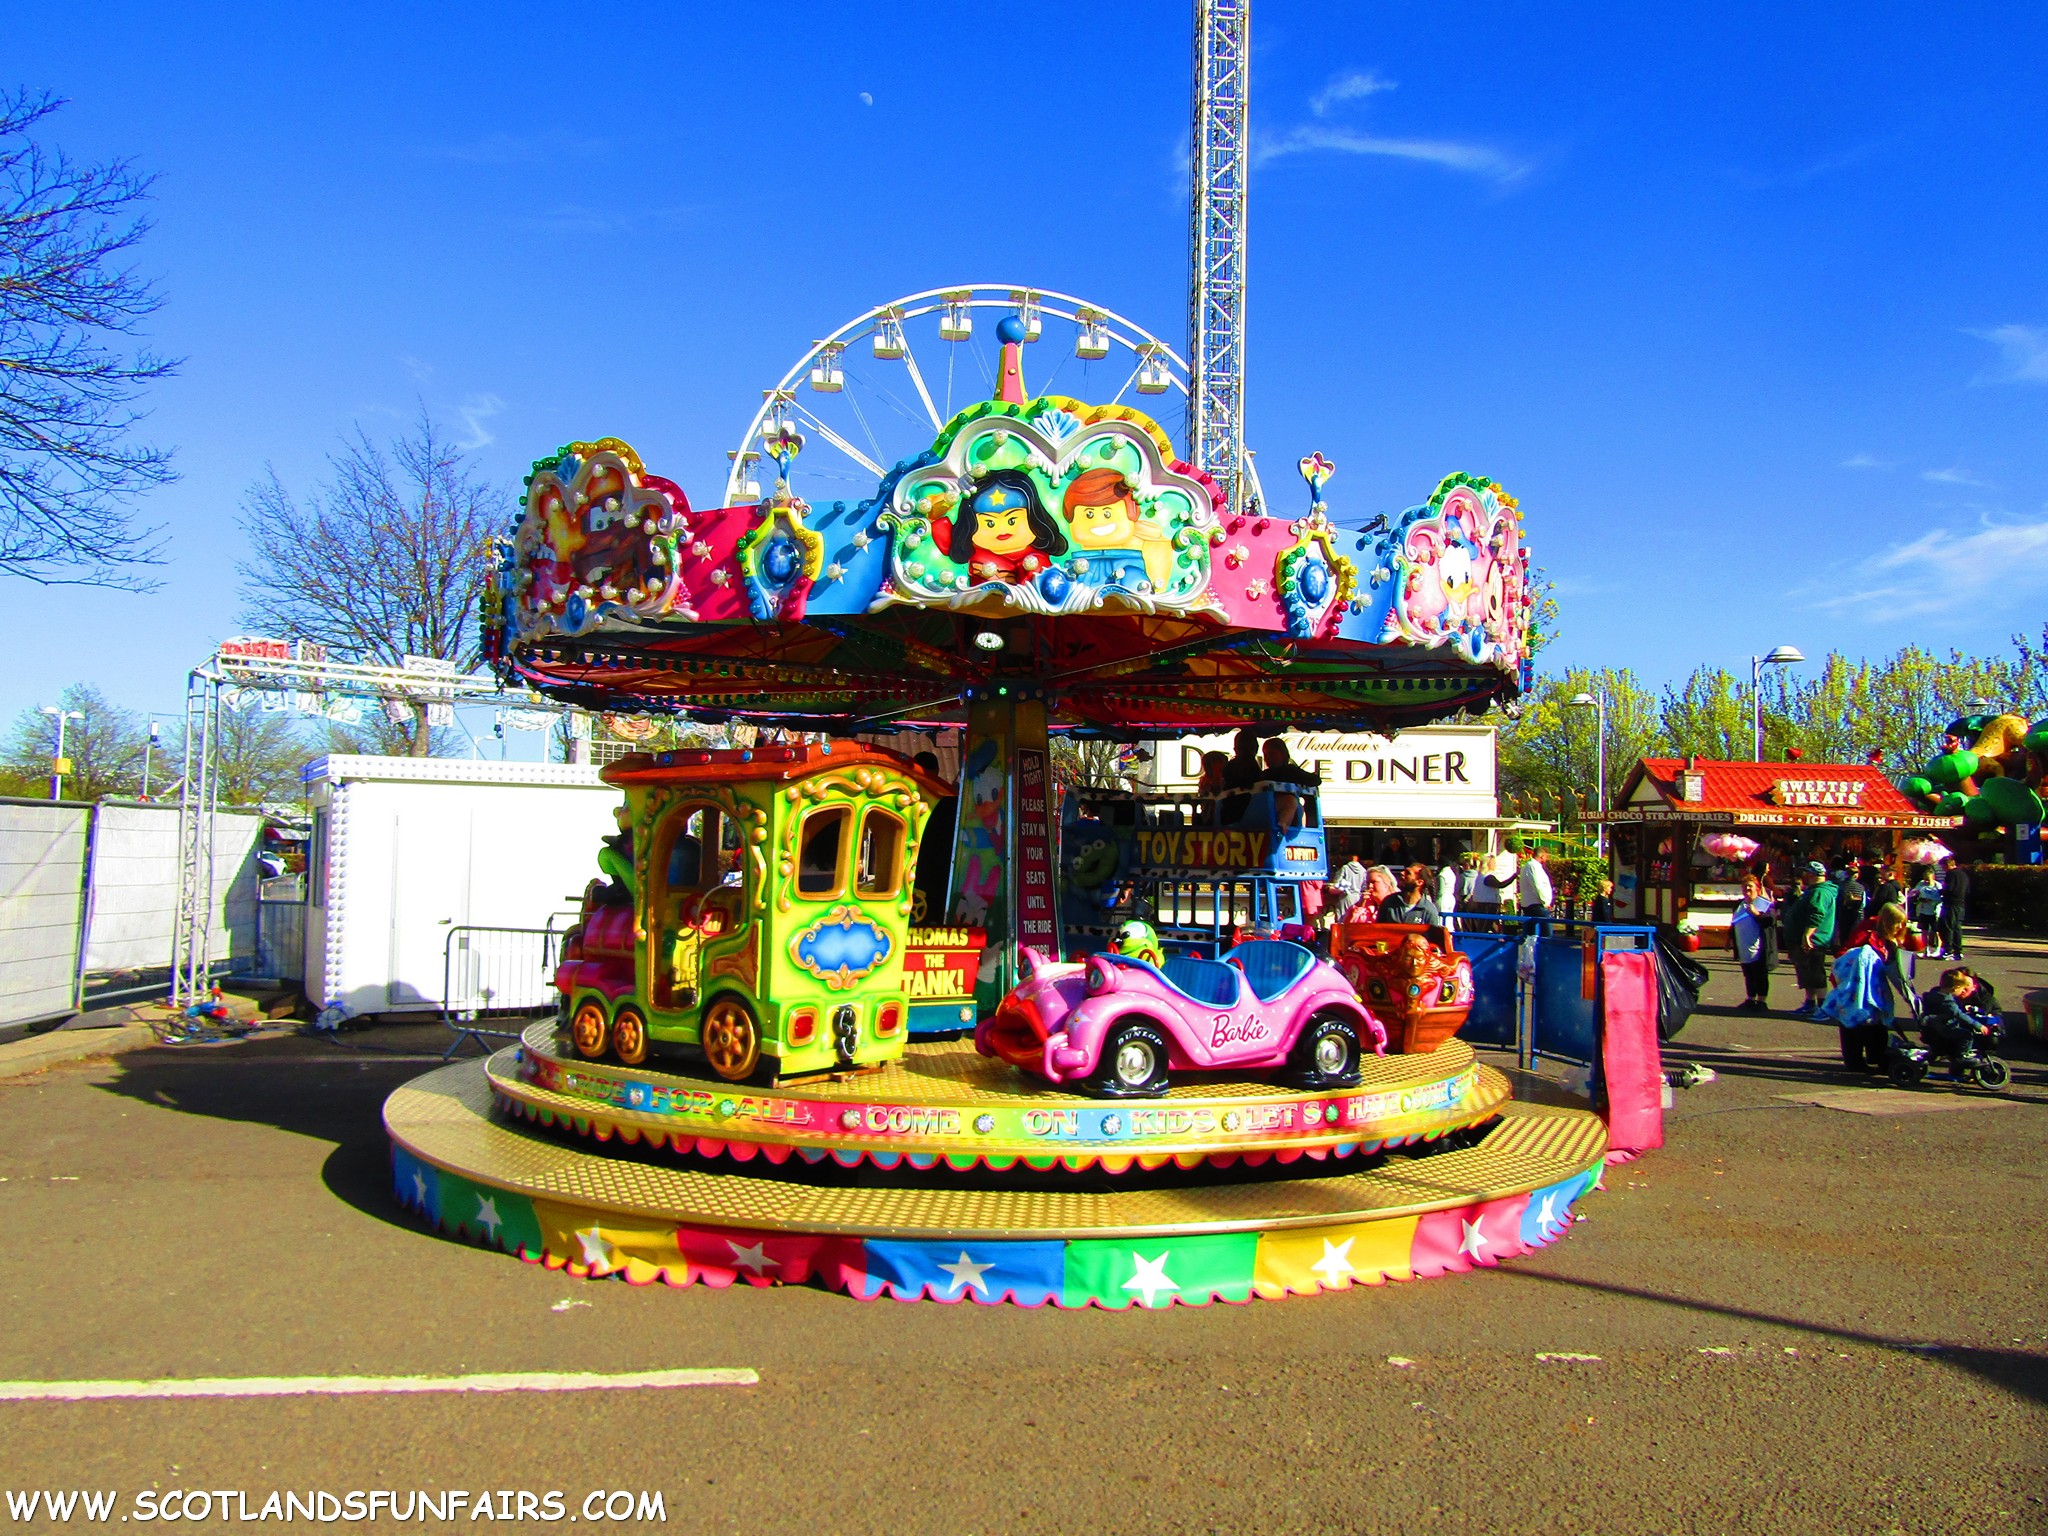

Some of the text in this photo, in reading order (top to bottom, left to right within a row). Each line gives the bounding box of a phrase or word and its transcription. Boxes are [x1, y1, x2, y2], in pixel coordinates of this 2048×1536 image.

[1022, 756, 1040, 771] HOLD
[1346, 751, 1470, 784] DINER
[1780, 781, 1866, 792] SWEETS &
[1021, 798, 1045, 812] PLEASE
[1783, 792, 1859, 805] TREATS
[1608, 811, 1731, 822] CHOCO STRAWBERRIES
[1739, 813, 1784, 823] DRINKS
[1805, 815, 1828, 825] ICE
[1843, 816, 1887, 826] CREAM
[1912, 817, 1951, 827] SLUSH
[1021, 823, 1046, 836] STAY IN
[1026, 846, 1043, 860] YOUR
[1137, 831, 1265, 867] TOY STORY
[1026, 871, 1046, 885] SEATS
[1027, 896, 1046, 909] UNTIL
[1024, 920, 1052, 934] THE RIDE
[907, 928, 969, 946] THOMAS
[924, 954, 945, 968] THE
[903, 969, 964, 996] TANK!
[1117, 1029, 1162, 1046] DUNLOP
[1211, 1014, 1269, 1048] Barbie
[1316, 1023, 1356, 1038] DUNLOP
[651, 1086, 715, 1115] FOR
[735, 1097, 809, 1125] ALL
[866, 1105, 961, 1134] COME
[1023, 1109, 1078, 1135] ON
[1130, 1109, 1216, 1135] KIDS
